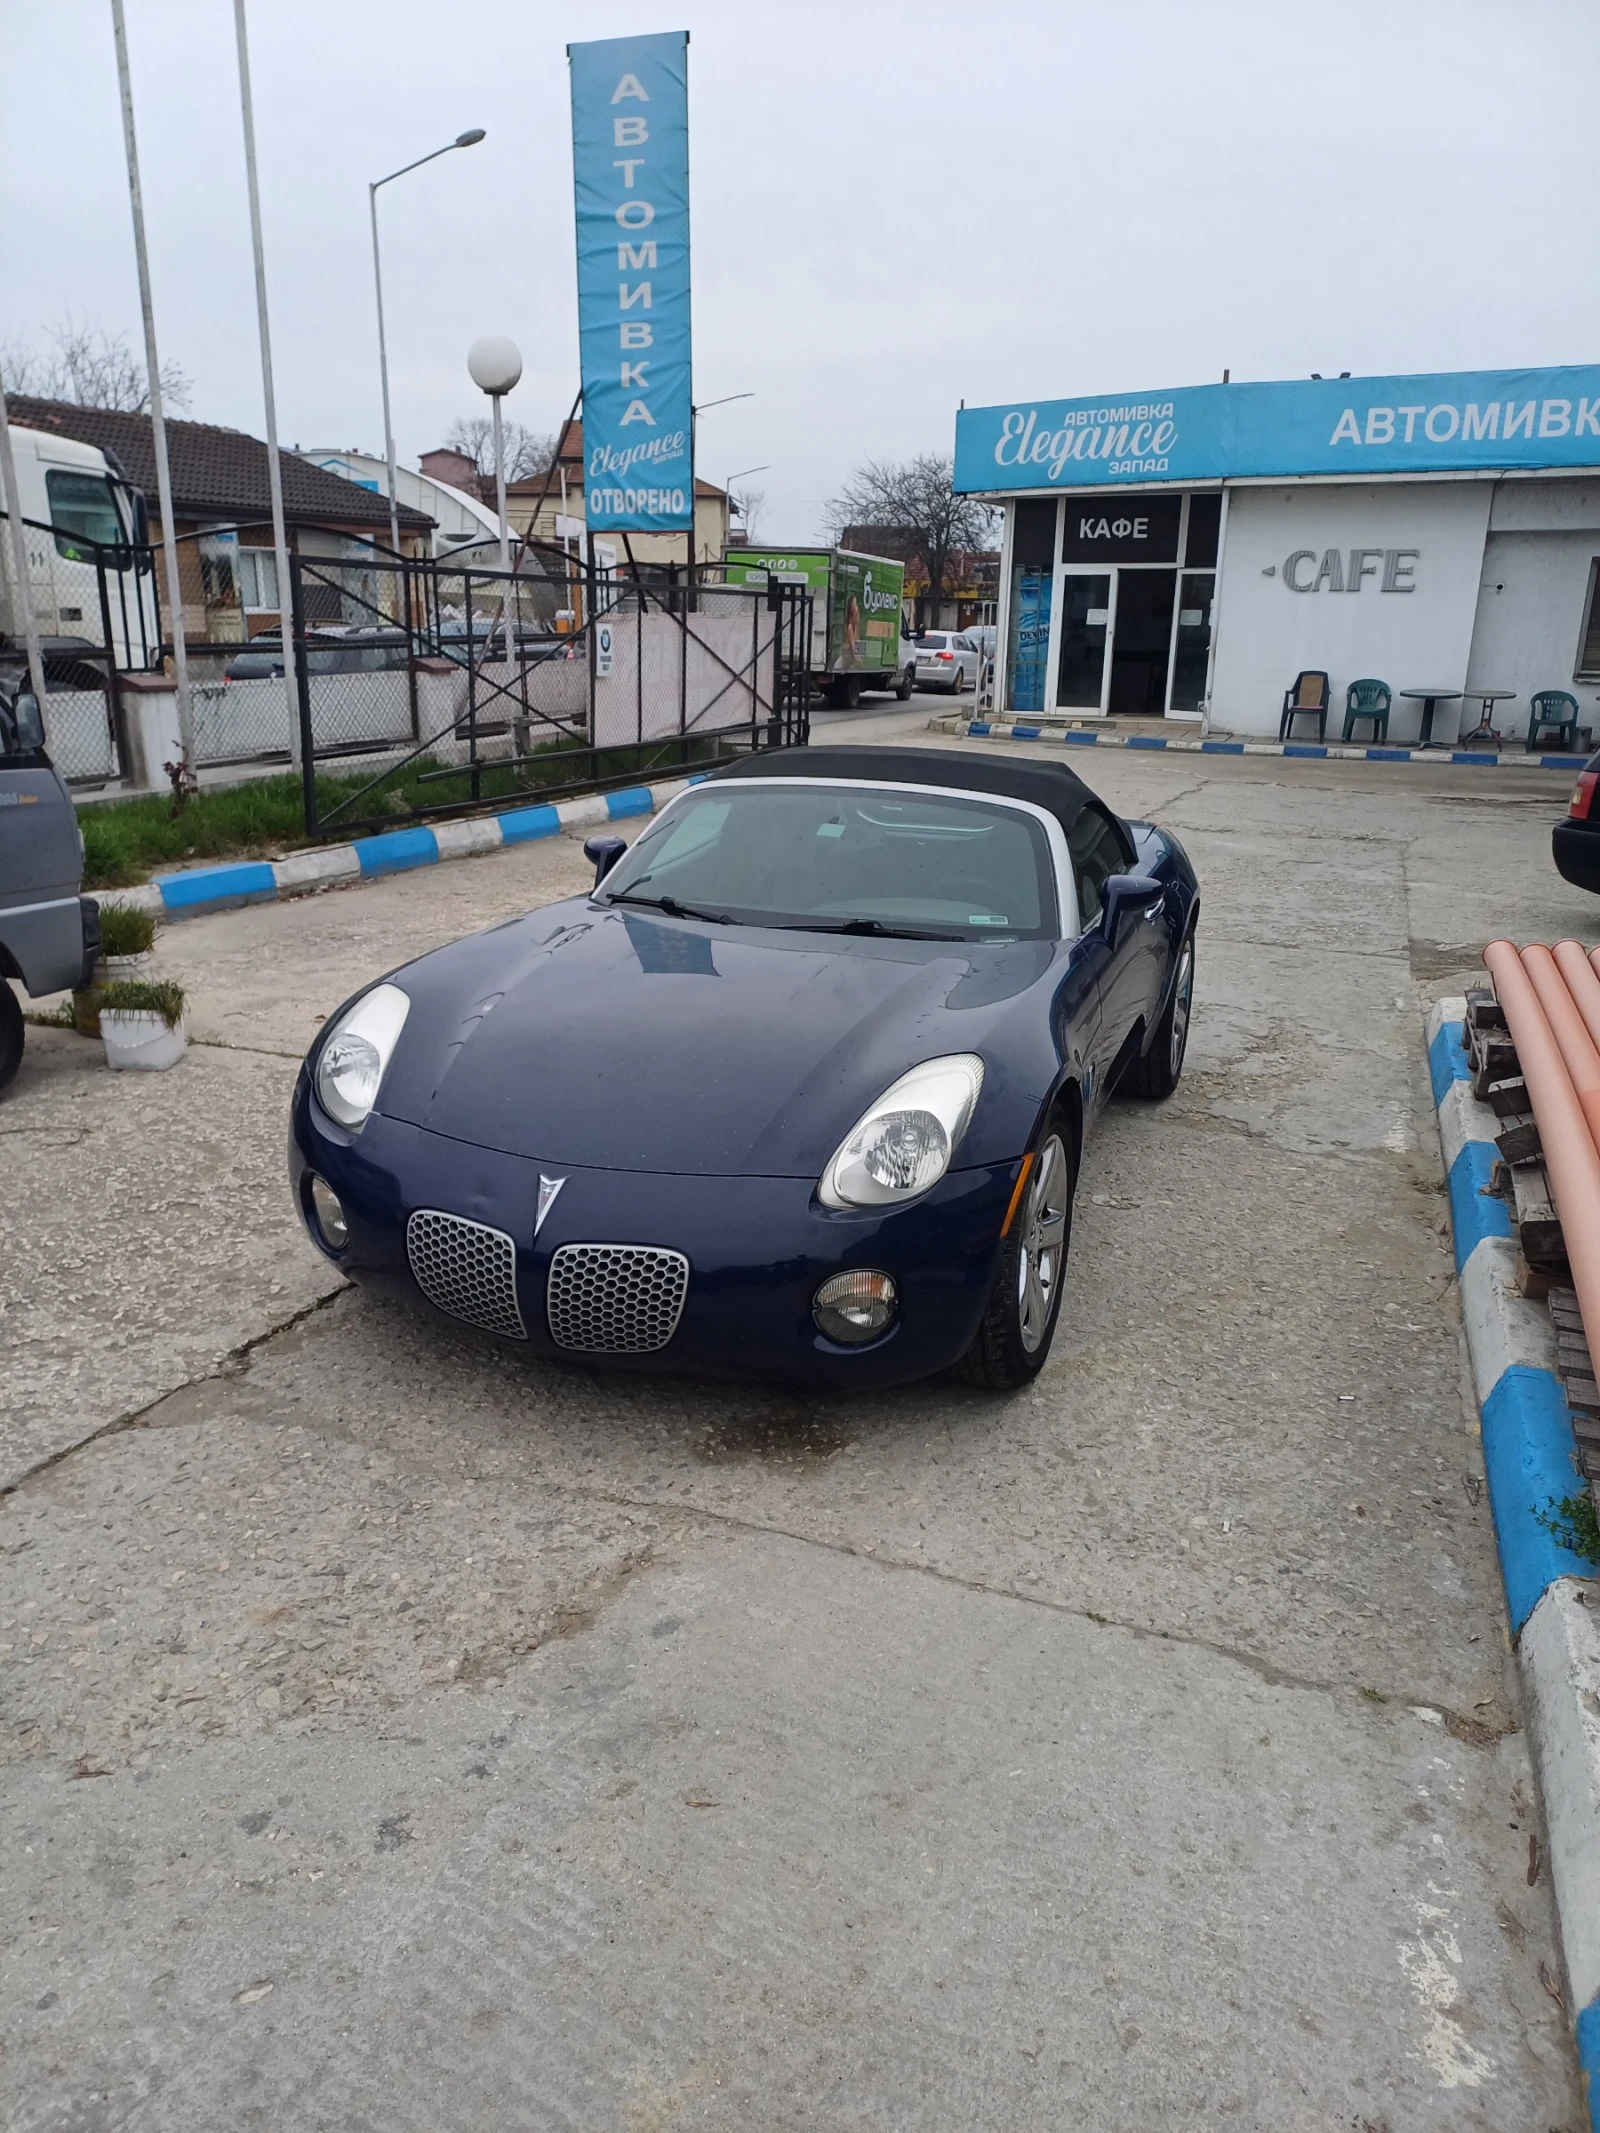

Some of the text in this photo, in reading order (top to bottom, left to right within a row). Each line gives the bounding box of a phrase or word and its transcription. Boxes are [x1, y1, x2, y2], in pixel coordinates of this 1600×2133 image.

[610, 73, 658, 427] АВТОМИВКА
[1064, 402, 1174, 427] АВТОМИВКА
[589, 430, 685, 477] Elegance
[994, 410, 1179, 480] Elegance
[1108, 457, 1169, 475] ЗАПАД
[590, 488, 685, 514] ОТВОРЕНО
[1079, 517, 1150, 539] КАФЕ
[1282, 548, 1421, 593] CAFE
